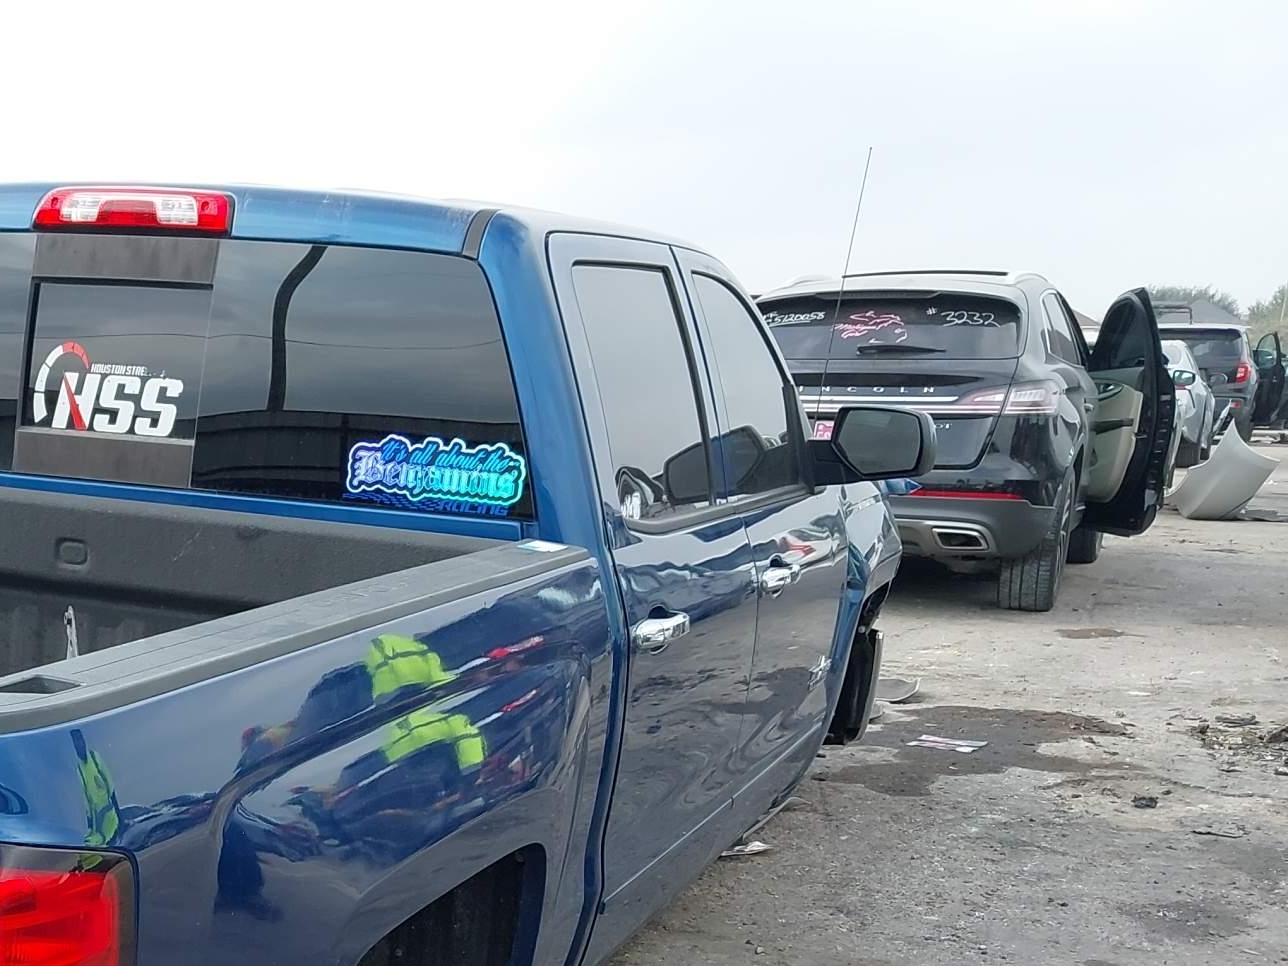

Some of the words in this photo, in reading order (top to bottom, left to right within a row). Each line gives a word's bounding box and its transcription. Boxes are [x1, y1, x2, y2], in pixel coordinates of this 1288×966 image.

[91, 363, 126, 375] HOUSTON
[798, 385, 935, 394] INCOLN
[381, 440, 409, 461] It's
[409, 443, 438, 465] all
[436, 445, 482, 472] about
